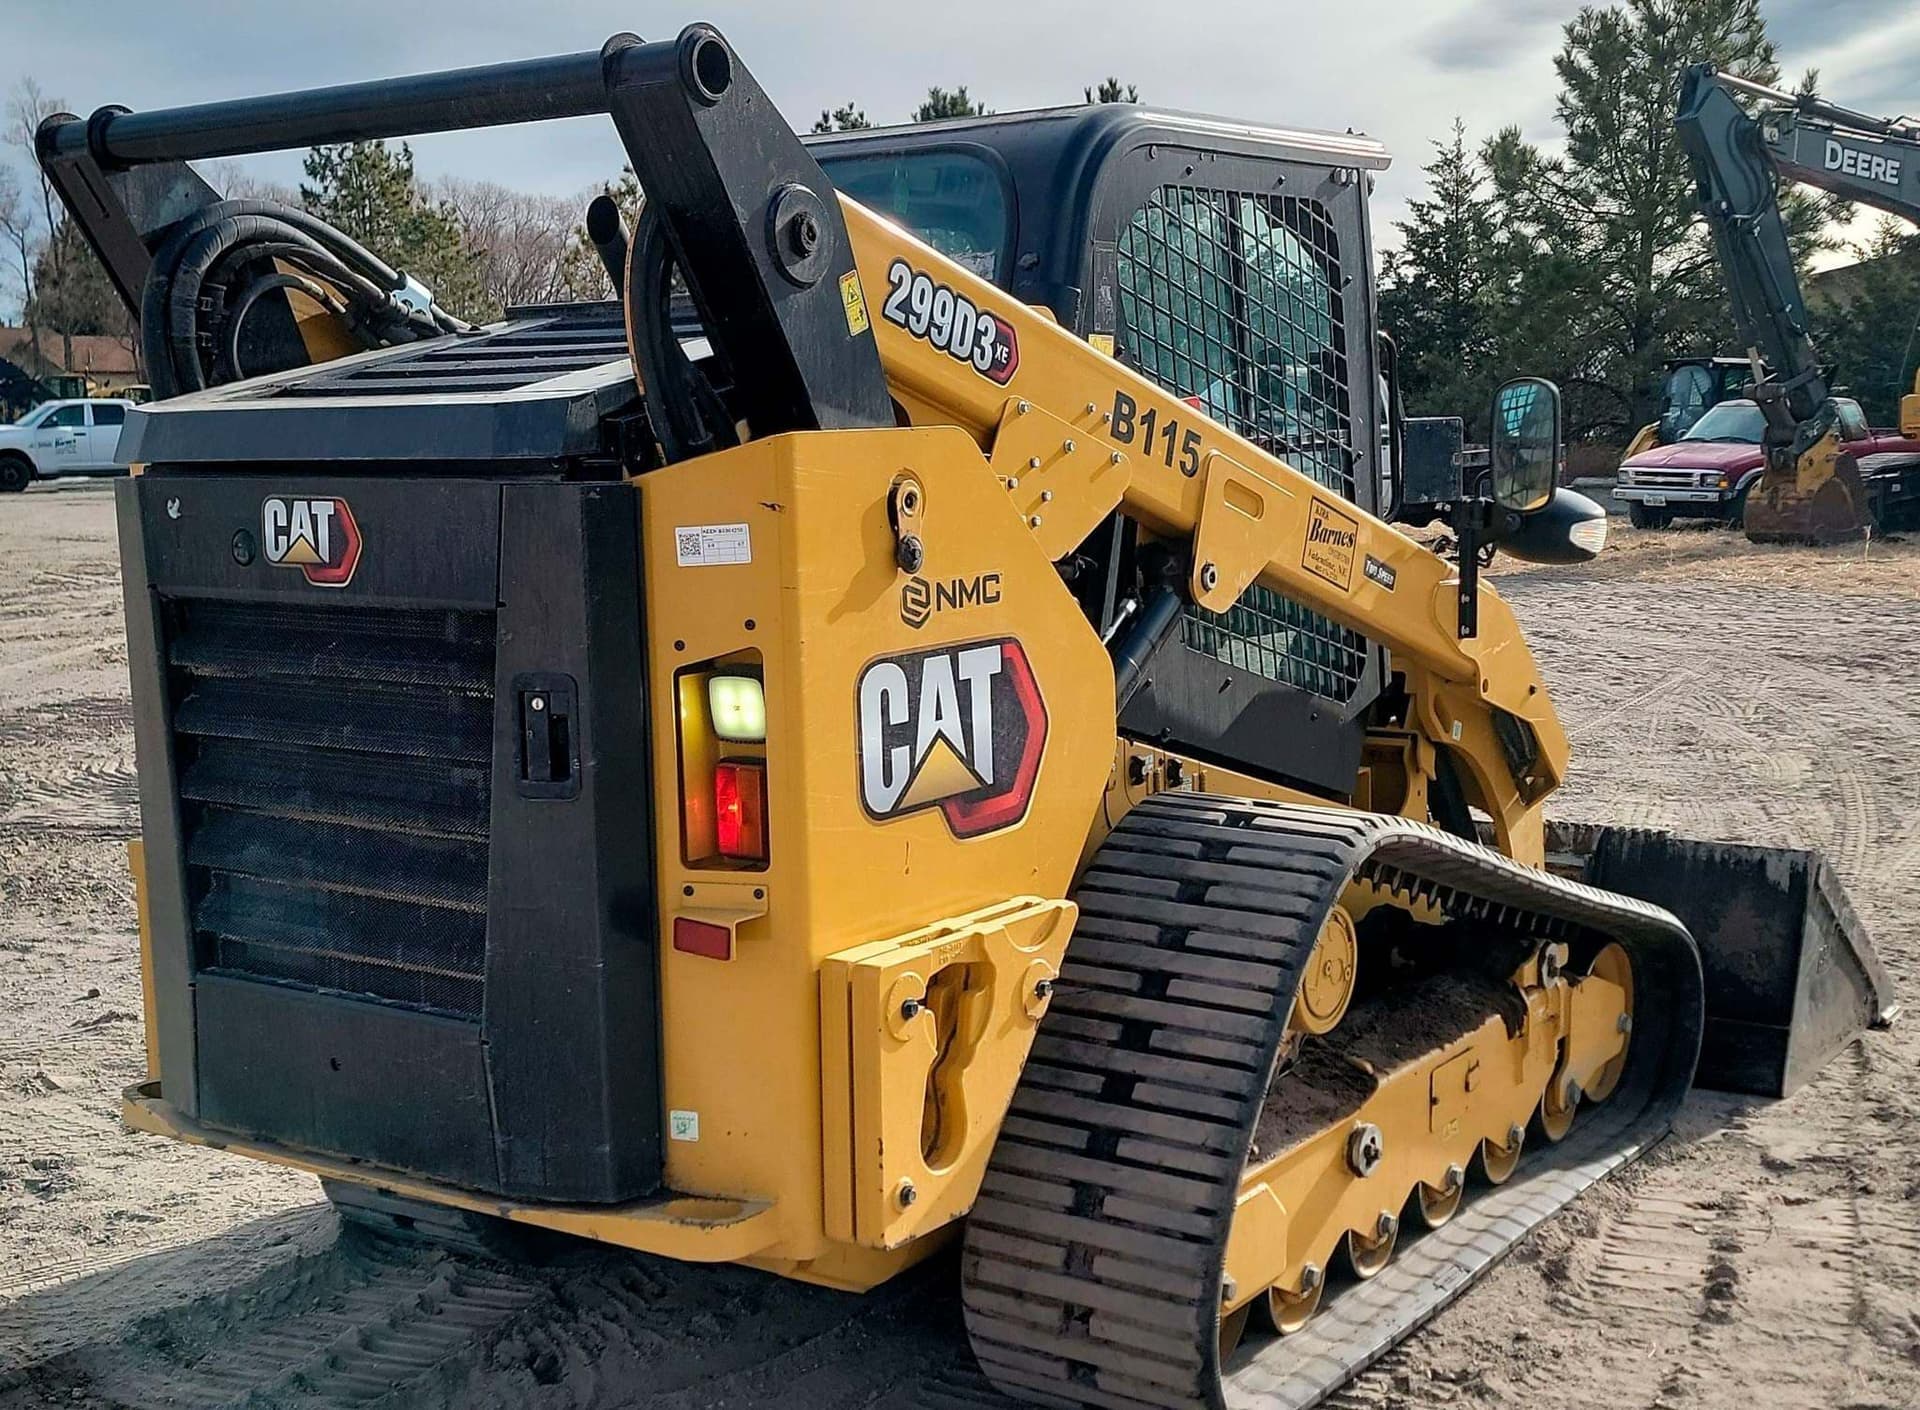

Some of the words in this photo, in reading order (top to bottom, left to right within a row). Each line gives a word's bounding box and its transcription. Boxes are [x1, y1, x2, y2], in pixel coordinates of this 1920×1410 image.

[1824, 139, 1900, 185] DEERE
[884, 262, 996, 371] 299D3
[994, 342, 1010, 364] XE
[1110, 390, 1202, 478] B115
[264, 499, 335, 564] CAT
[1308, 517, 1355, 549] Barnes
[936, 573, 1001, 611] NMC
[860, 644, 1002, 814] CAT
